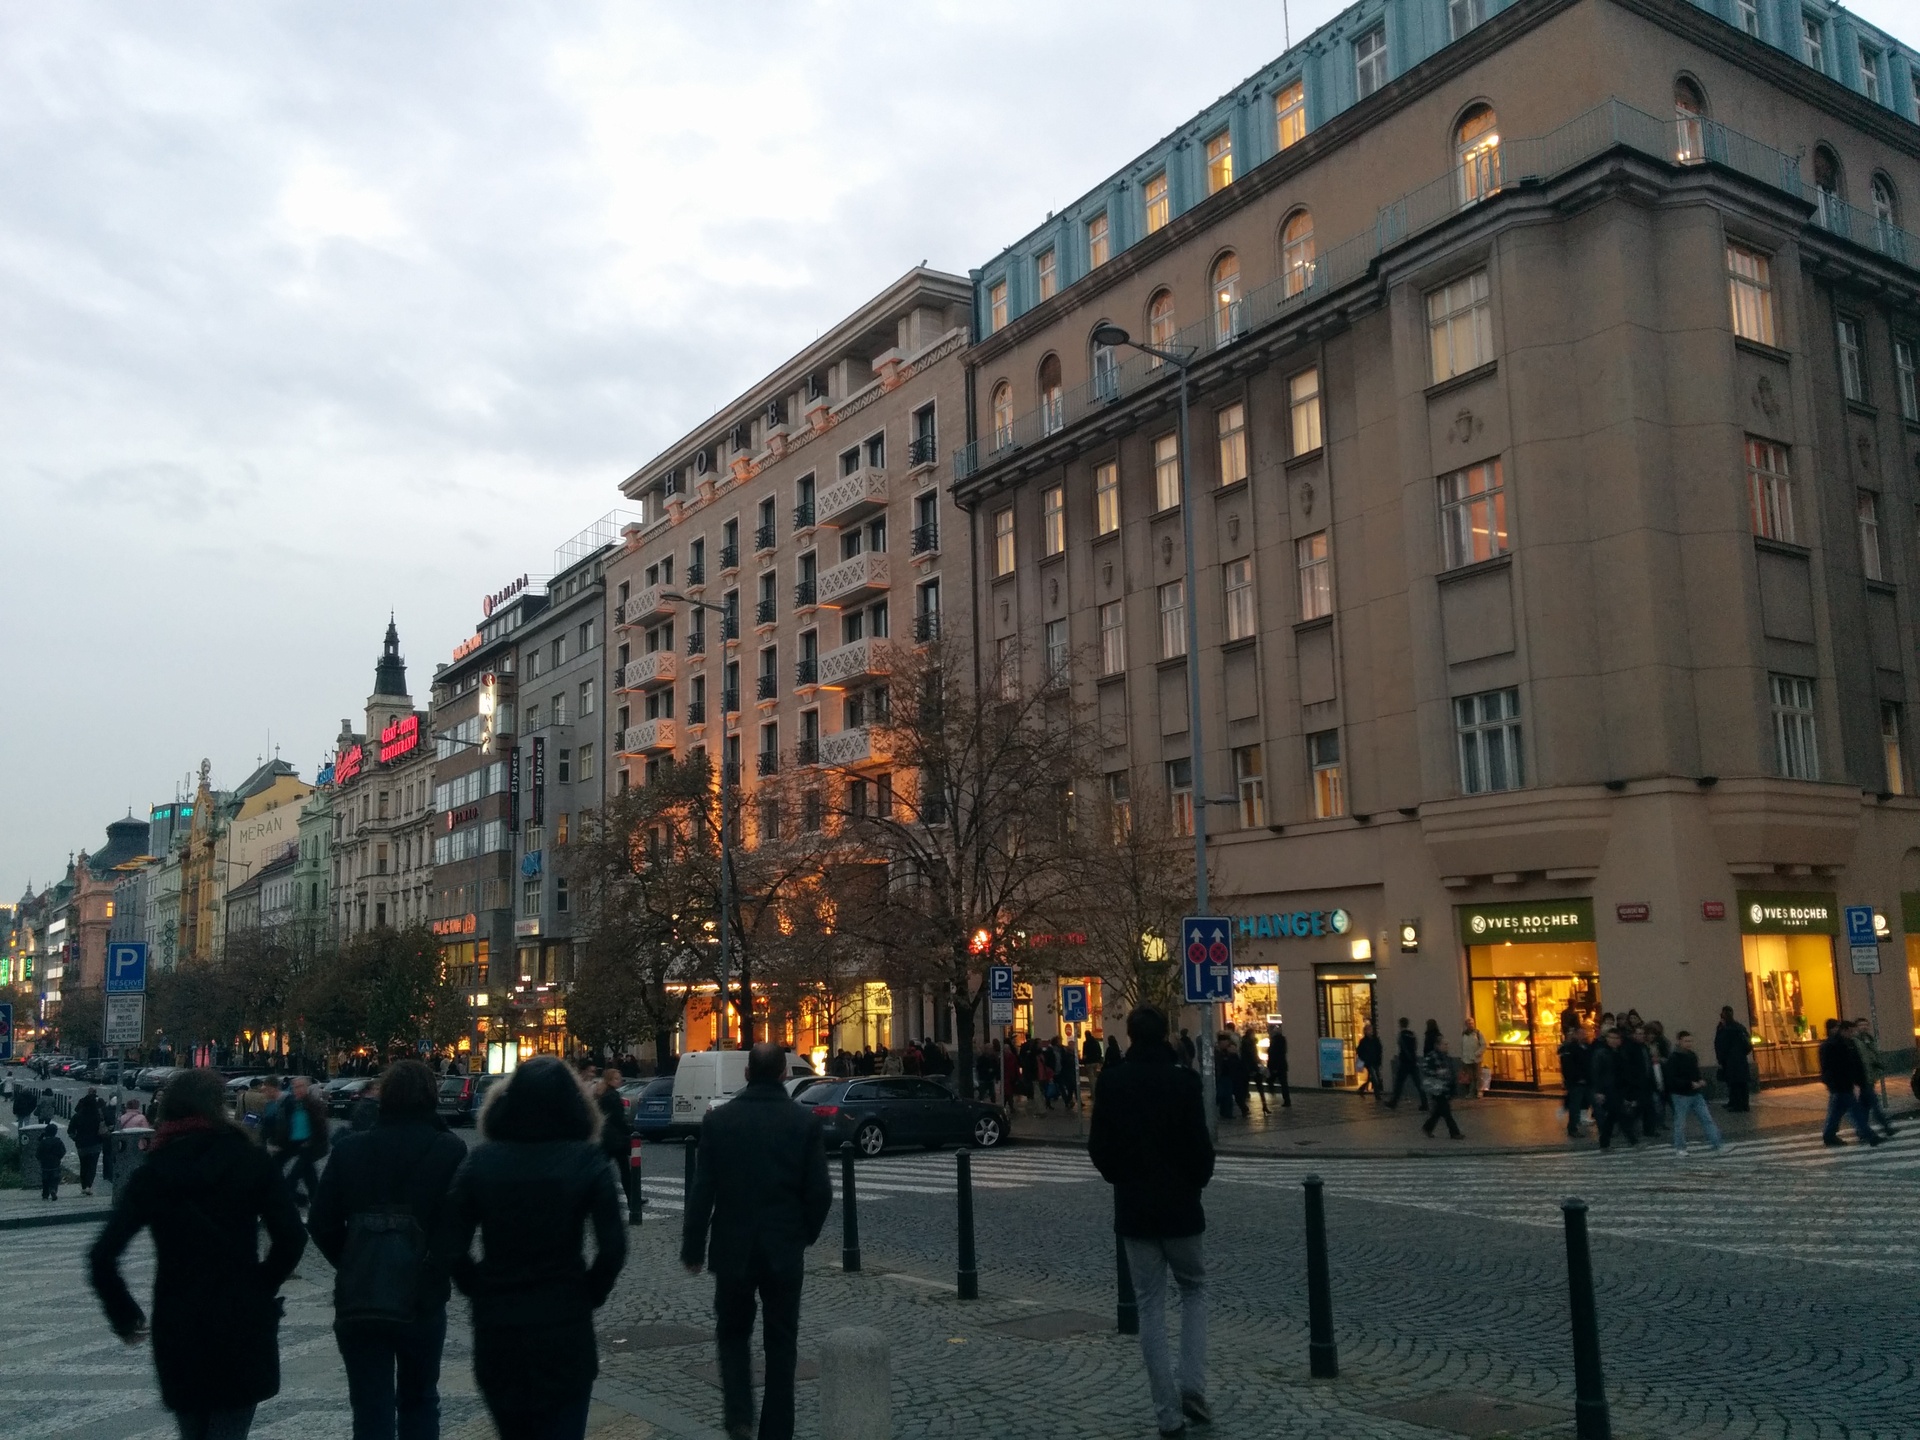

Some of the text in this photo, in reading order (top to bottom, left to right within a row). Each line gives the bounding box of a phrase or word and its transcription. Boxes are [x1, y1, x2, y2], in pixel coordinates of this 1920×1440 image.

[492, 573, 529, 608] RAMADA
[239, 817, 282, 844] MERAN
[1232, 911, 1325, 938] HANGE
[1487, 914, 1579, 929] YVES ROCHER
[1764, 908, 1828, 919] YVES ROCHER
[1851, 911, 1868, 934] P
[115, 948, 139, 977] P
[994, 970, 1009, 991] P
[1067, 989, 1083, 1012] P
